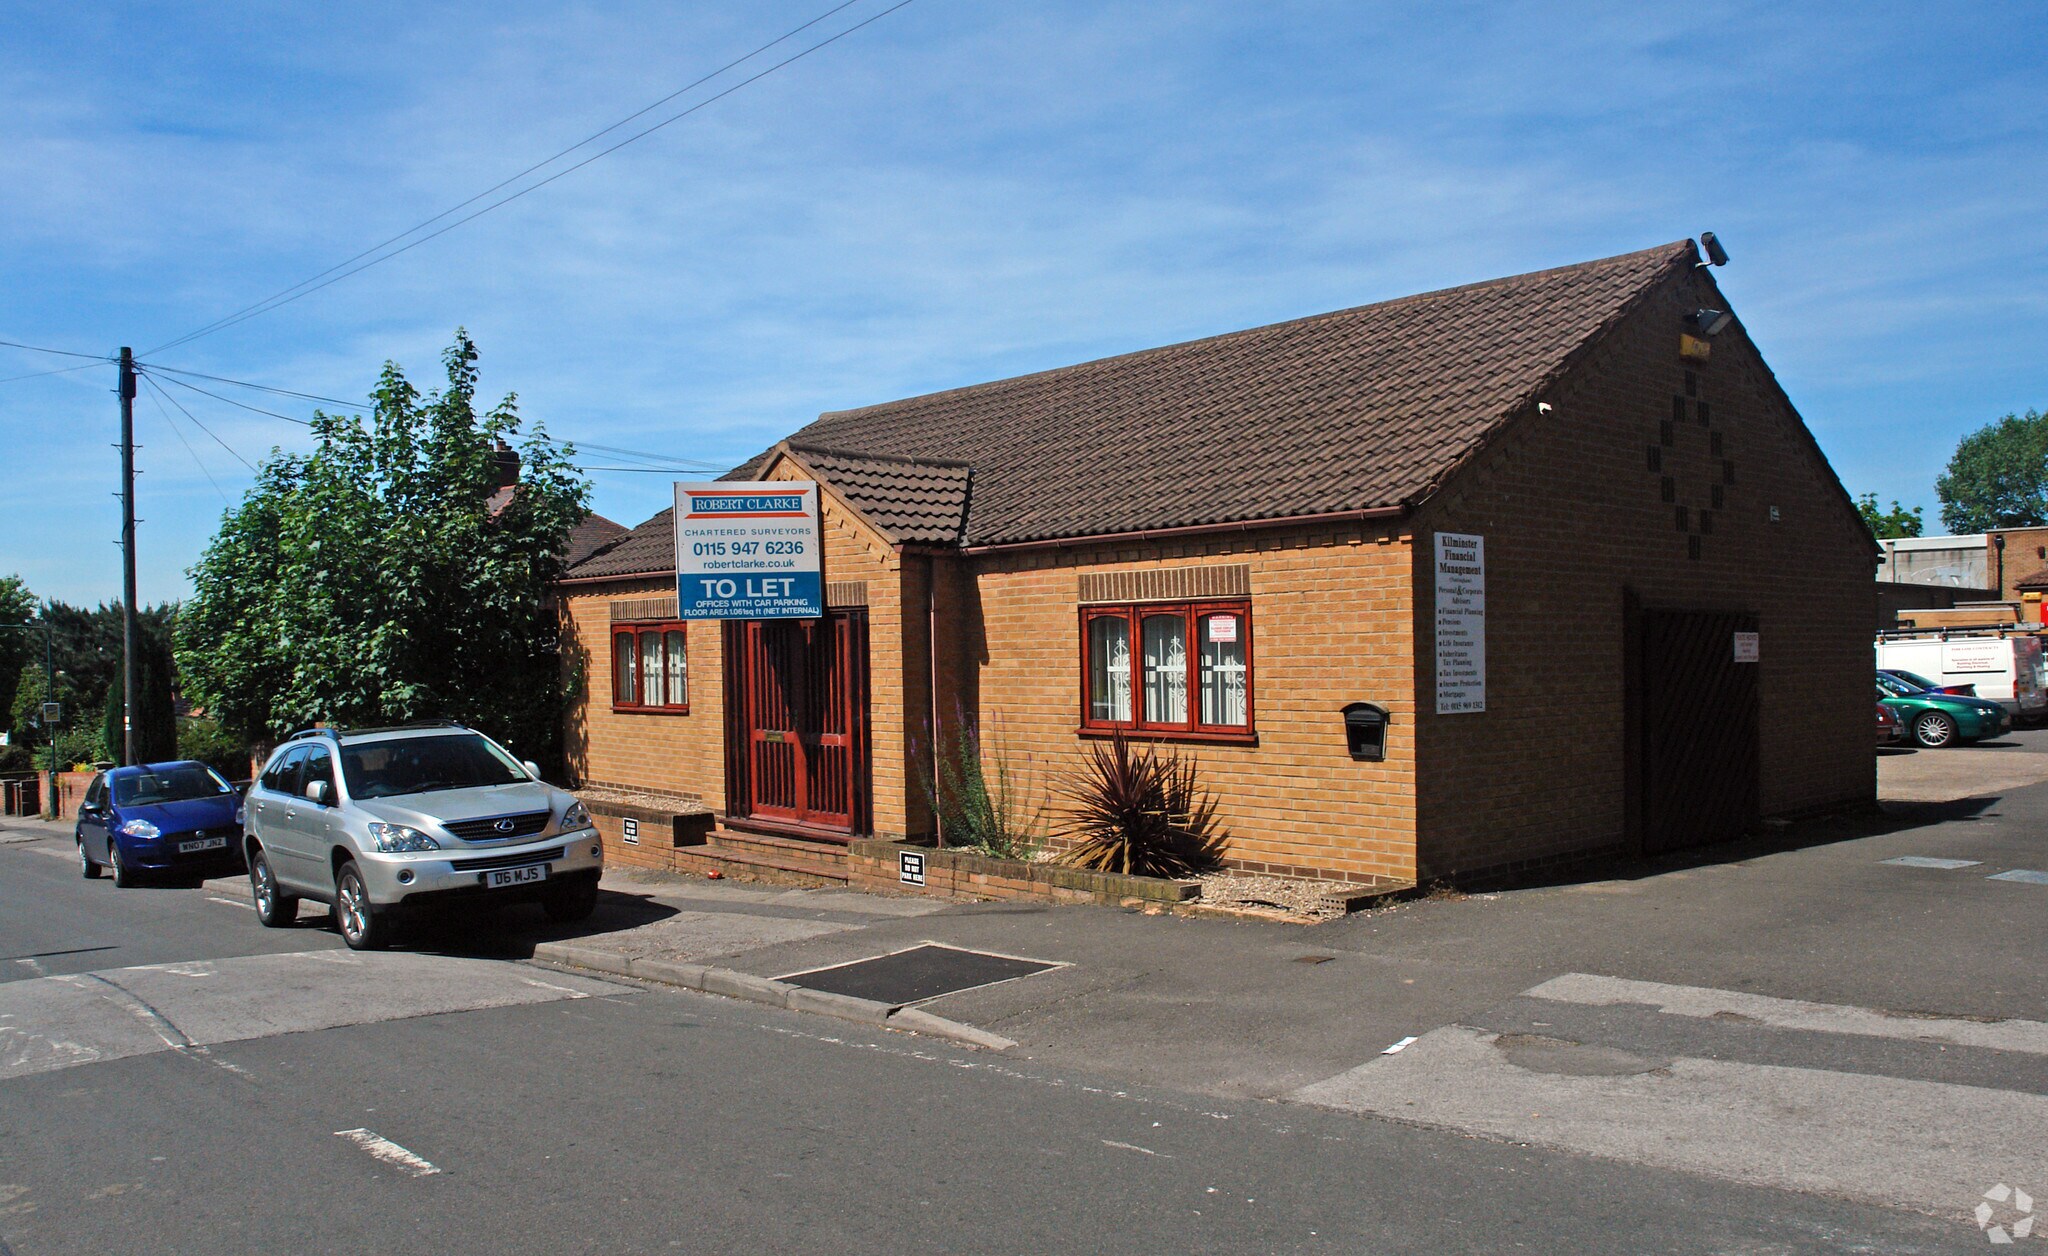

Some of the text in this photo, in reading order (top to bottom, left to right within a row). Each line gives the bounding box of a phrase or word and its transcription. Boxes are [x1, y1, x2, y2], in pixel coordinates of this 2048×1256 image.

[696, 498, 800, 510] ROBERT CLARKE
[751, 528, 811, 536] SURVEYORS
[1442, 536, 1477, 548] Kilminster
[693, 541, 804, 556] 0115 947 6236
[1445, 550, 1476, 562] Financial
[704, 559, 795, 569] robertclarke.co.uk
[1440, 562, 1482, 576] Management
[700, 578, 795, 598] TO LET
[1457, 585, 1462, 595] &
[1462, 587, 1483, 595] Corporate
[696, 600, 730, 608] OFFICES
[774, 598, 808, 606] PARKING
[684, 608, 708, 616] FLOOR
[709, 608, 728, 616] AREA
[764, 607, 780, 616] (NET
[782, 606, 819, 615] INTERNAL)
[1464, 608, 1483, 616] Planning
[905, 856, 919, 865] PLEASE
[905, 864, 920, 873] DO NOT
[495, 868, 538, 884] D6 MJS
[902, 872, 923, 882] PARK HERE
